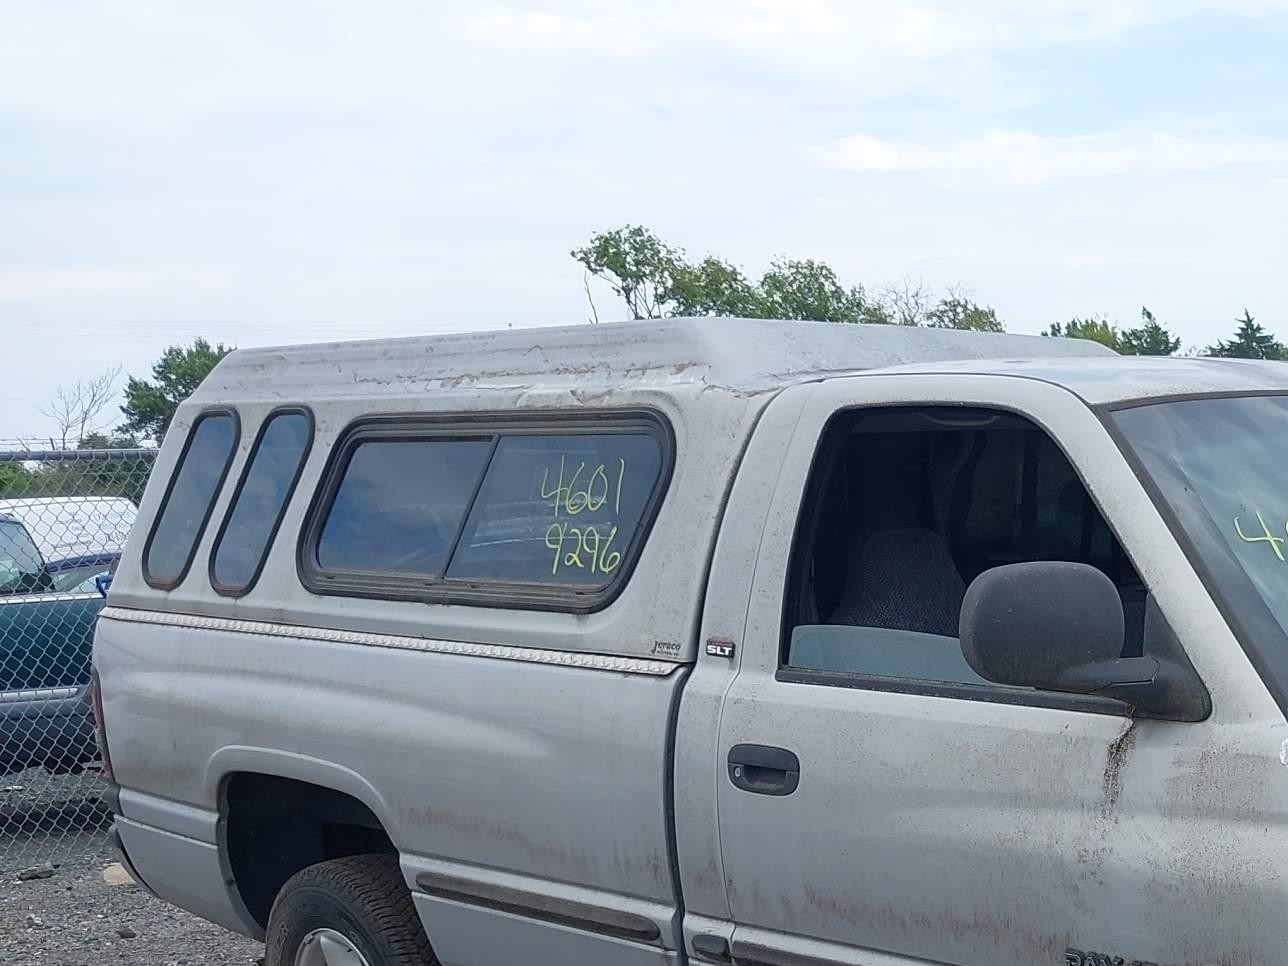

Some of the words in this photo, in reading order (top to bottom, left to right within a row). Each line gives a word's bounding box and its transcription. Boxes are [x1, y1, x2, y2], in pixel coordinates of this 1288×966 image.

[541, 454, 625, 517] 4601
[545, 522, 621, 575] 9296
[707, 645, 732, 656] SLT
